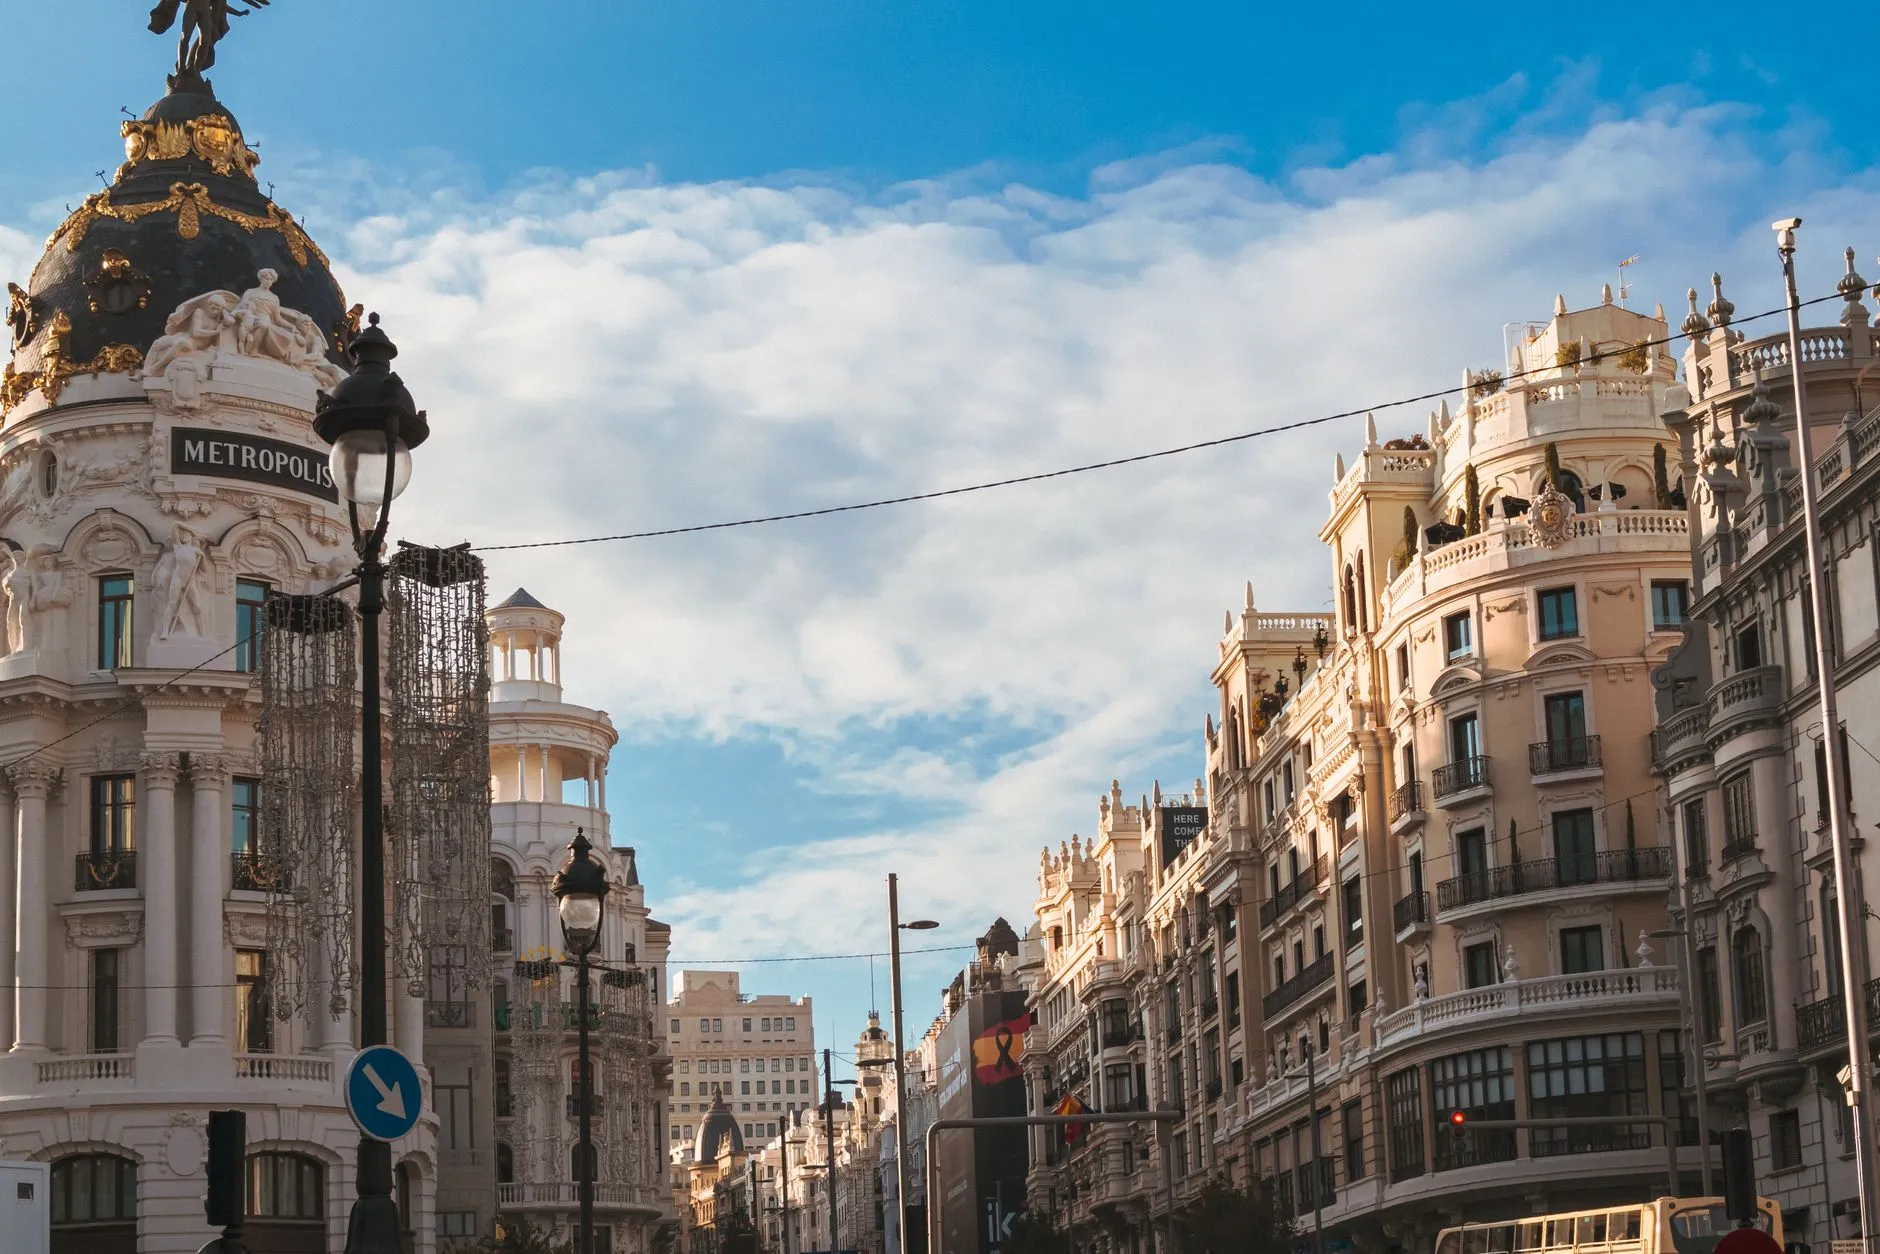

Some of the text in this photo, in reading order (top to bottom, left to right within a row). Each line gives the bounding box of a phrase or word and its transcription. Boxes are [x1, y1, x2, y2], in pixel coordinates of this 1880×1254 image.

[184, 439, 333, 489] METROPOLIS
[1173, 814, 1200, 824] HERE
[1174, 839, 1193, 848] TH
